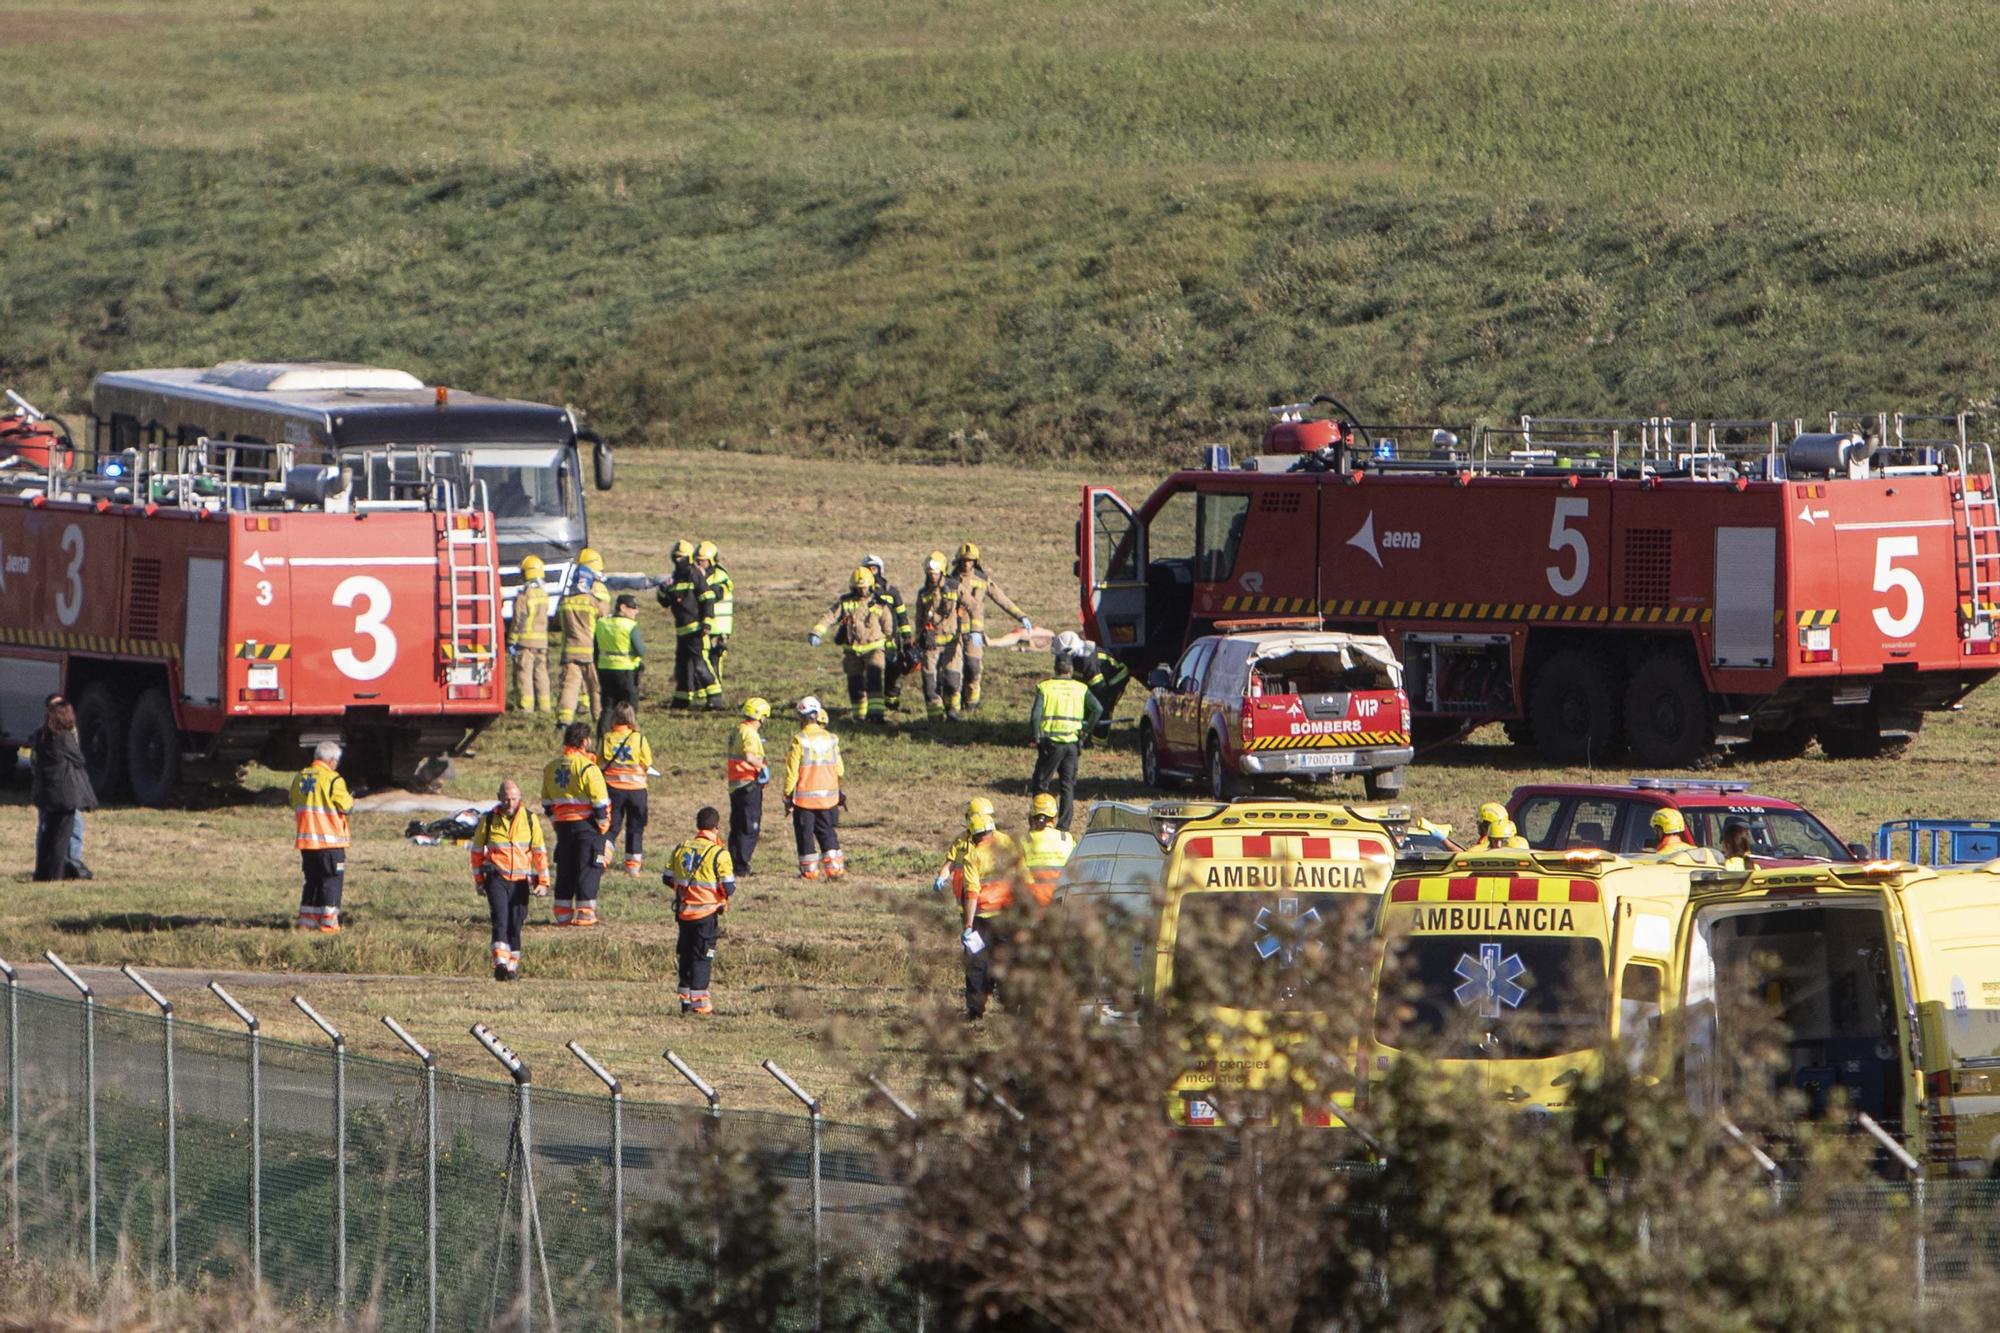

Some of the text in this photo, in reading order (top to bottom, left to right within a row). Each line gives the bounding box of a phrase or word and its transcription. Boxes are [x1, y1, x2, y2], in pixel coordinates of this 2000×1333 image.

[1382, 531, 1421, 549] aena
[1546, 497, 1590, 597] 5
[56, 524, 84, 625] 3
[1871, 536, 1925, 638] 5
[255, 580, 273, 606] 3
[331, 575, 398, 681] 3
[1355, 699, 1379, 717] VIP
[1290, 720, 1362, 735] BOMBERS
[1411, 902, 1575, 931] AMBULÀNCIA
